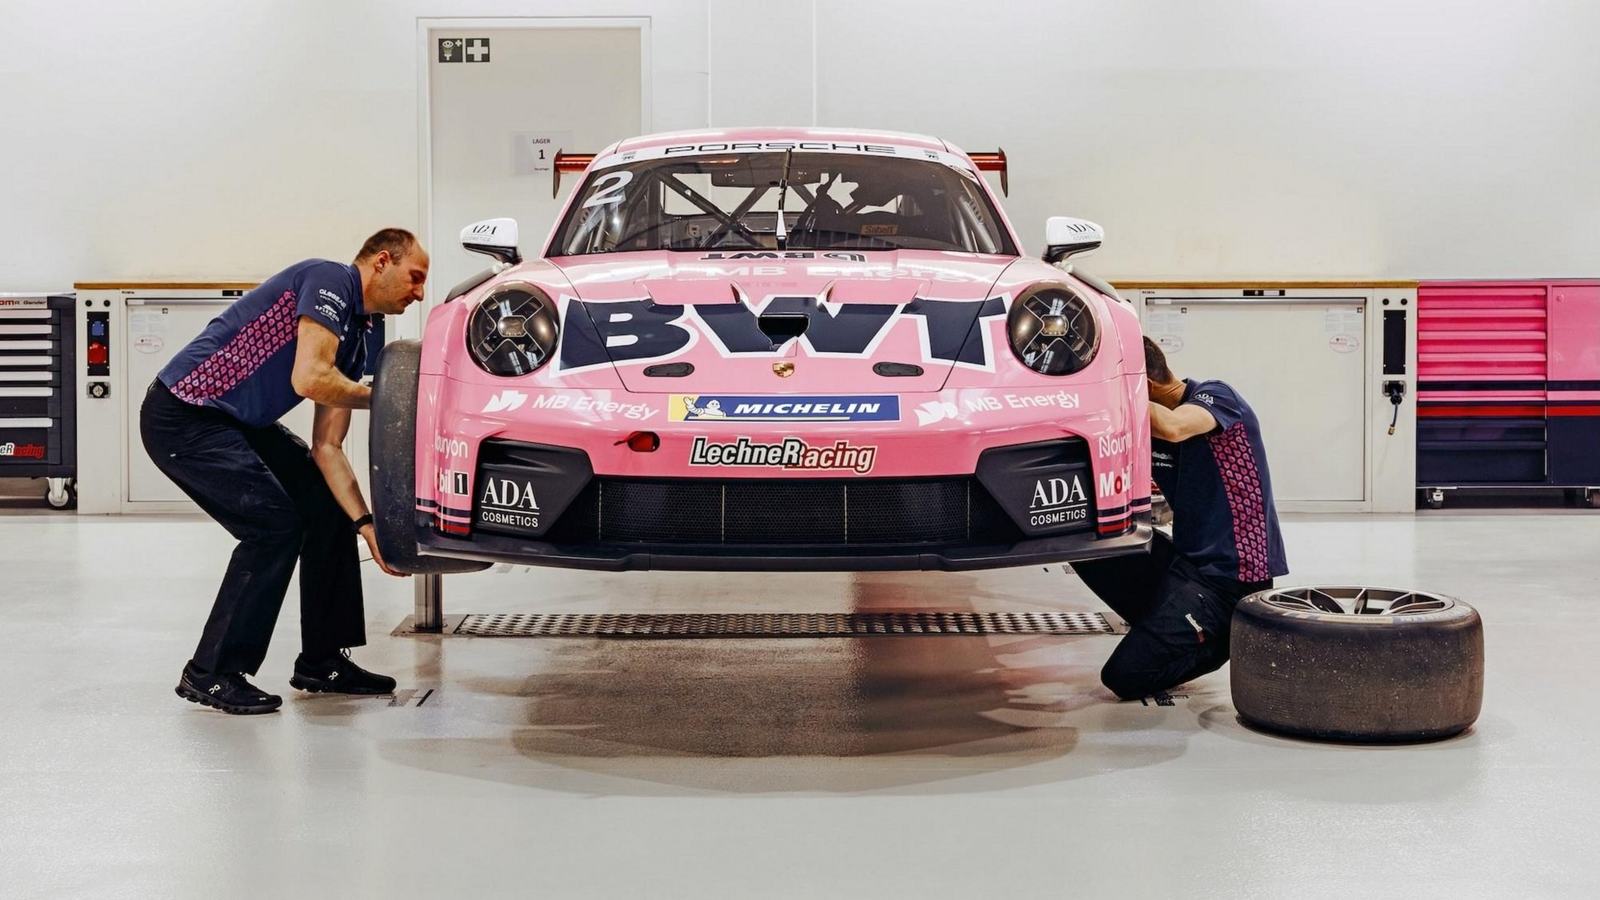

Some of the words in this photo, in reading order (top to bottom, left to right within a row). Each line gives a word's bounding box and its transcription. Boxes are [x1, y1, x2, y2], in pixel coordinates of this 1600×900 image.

[538, 149, 546, 160] 1
[665, 143, 896, 155] PORSCHE
[582, 171, 633, 208] 2
[557, 294, 1009, 375] BWT
[531, 394, 566, 409] MB
[573, 395, 660, 421] Energy
[734, 403, 880, 414] MICHELIN
[965, 396, 1003, 412] MB
[1004, 390, 1080, 409] Energy
[456, 473, 465, 494] 1
[481, 477, 540, 510] ADA
[1029, 474, 1088, 508] ADA
[482, 511, 539, 528] COSMETICS
[1030, 508, 1087, 526] COSMETICS
